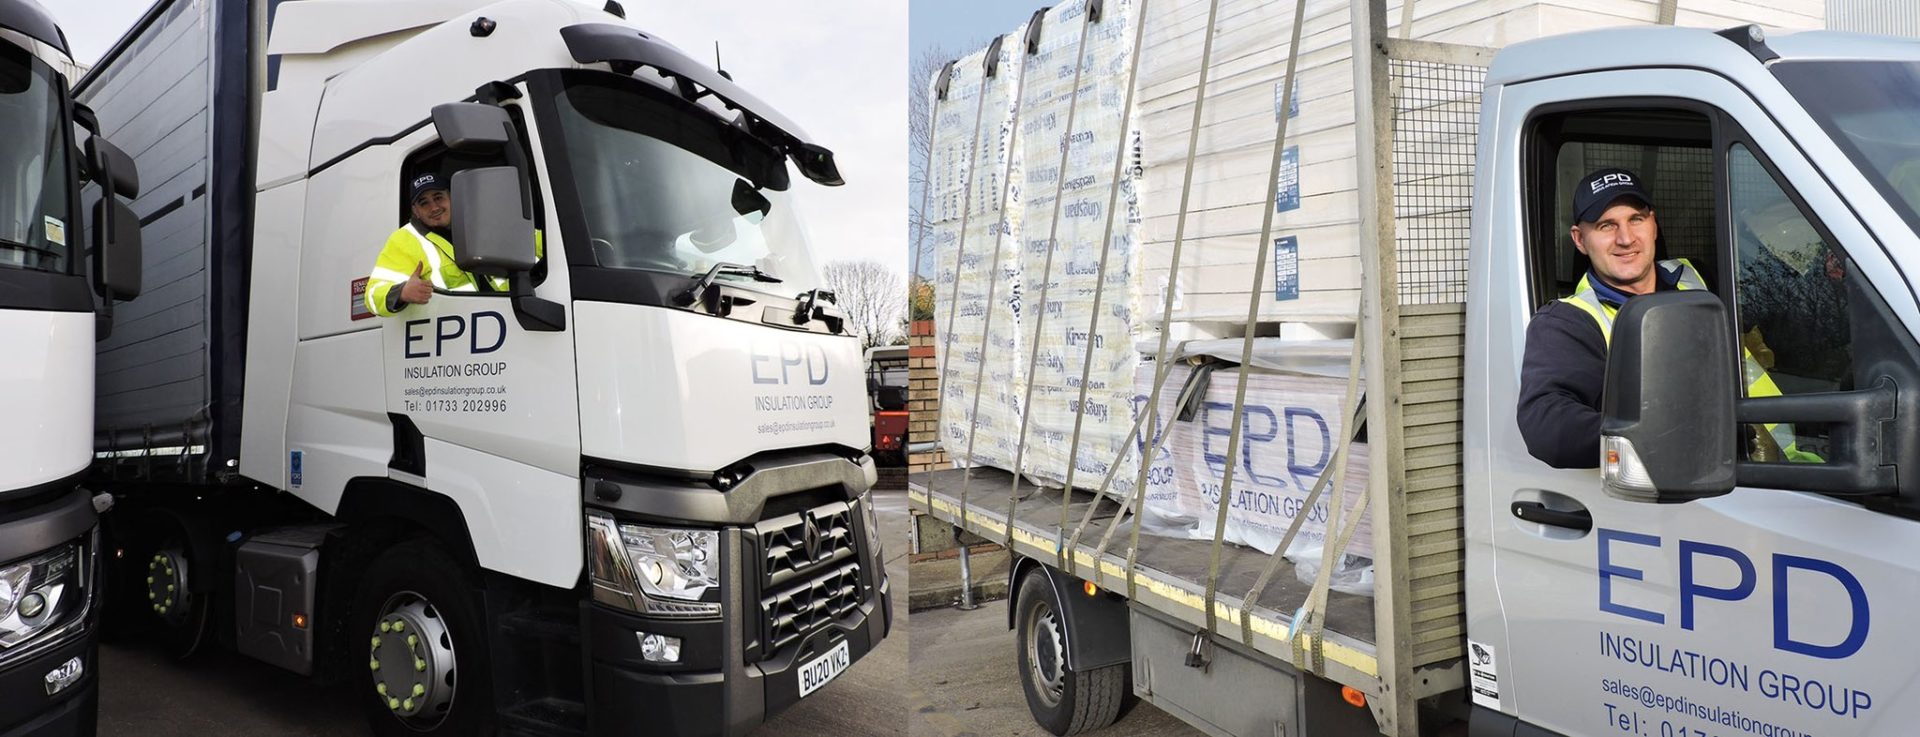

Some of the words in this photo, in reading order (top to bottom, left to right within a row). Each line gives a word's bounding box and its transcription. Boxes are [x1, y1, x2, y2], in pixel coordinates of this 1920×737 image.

[414, 174, 434, 187] EPD
[1062, 174, 1096, 191] ingspan
[1590, 172, 1632, 191] EPD
[405, 311, 507, 359] EPD
[405, 364, 461, 379] INSULATION
[464, 362, 506, 377] GROUP
[1066, 375, 1106, 391] Kingpan
[404, 385, 507, 398] sales@epdinsulationgroup.co.uk
[754, 395, 806, 411] INSULATION
[807, 394, 833, 410] GROUP
[404, 400, 422, 412] Tel:
[425, 399, 458, 412] 01733
[462, 399, 507, 412] 202996
[1069, 396, 1108, 424] Kingsan
[1200, 401, 1332, 482] EPD
[1283, 497, 1329, 524] GROU
[1597, 527, 1870, 660] EPD
[803, 658, 830, 691] BU20
[830, 646, 847, 673] VKZ
[1600, 631, 1749, 692] INSULATION
[1758, 668, 1872, 719] GROUP
[1602, 678, 1812, 737] sales@epdinsulationgro
[1603, 703, 1648, 737] Tel:
